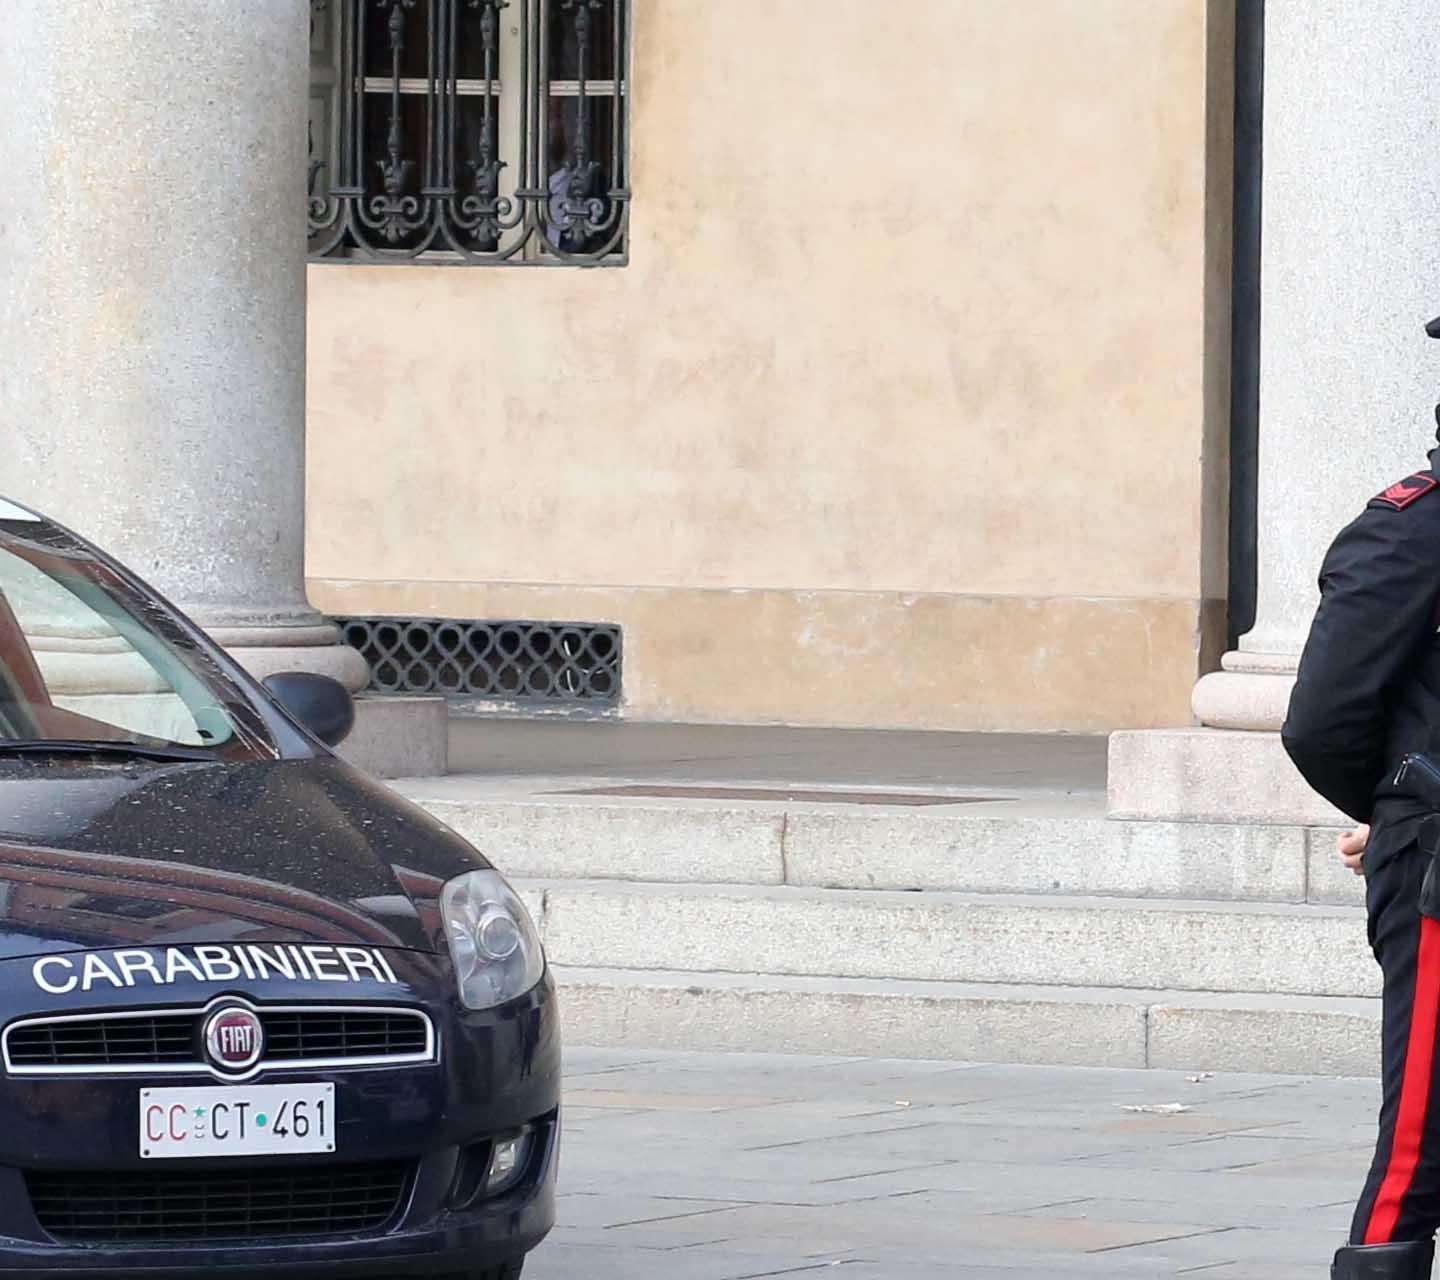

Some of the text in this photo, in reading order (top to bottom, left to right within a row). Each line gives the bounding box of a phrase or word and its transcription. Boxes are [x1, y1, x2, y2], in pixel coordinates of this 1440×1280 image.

[32, 945, 398, 994] CARABINIERI
[220, 1024, 254, 1053] FIAT
[145, 1099, 327, 1141] CC CT 461
